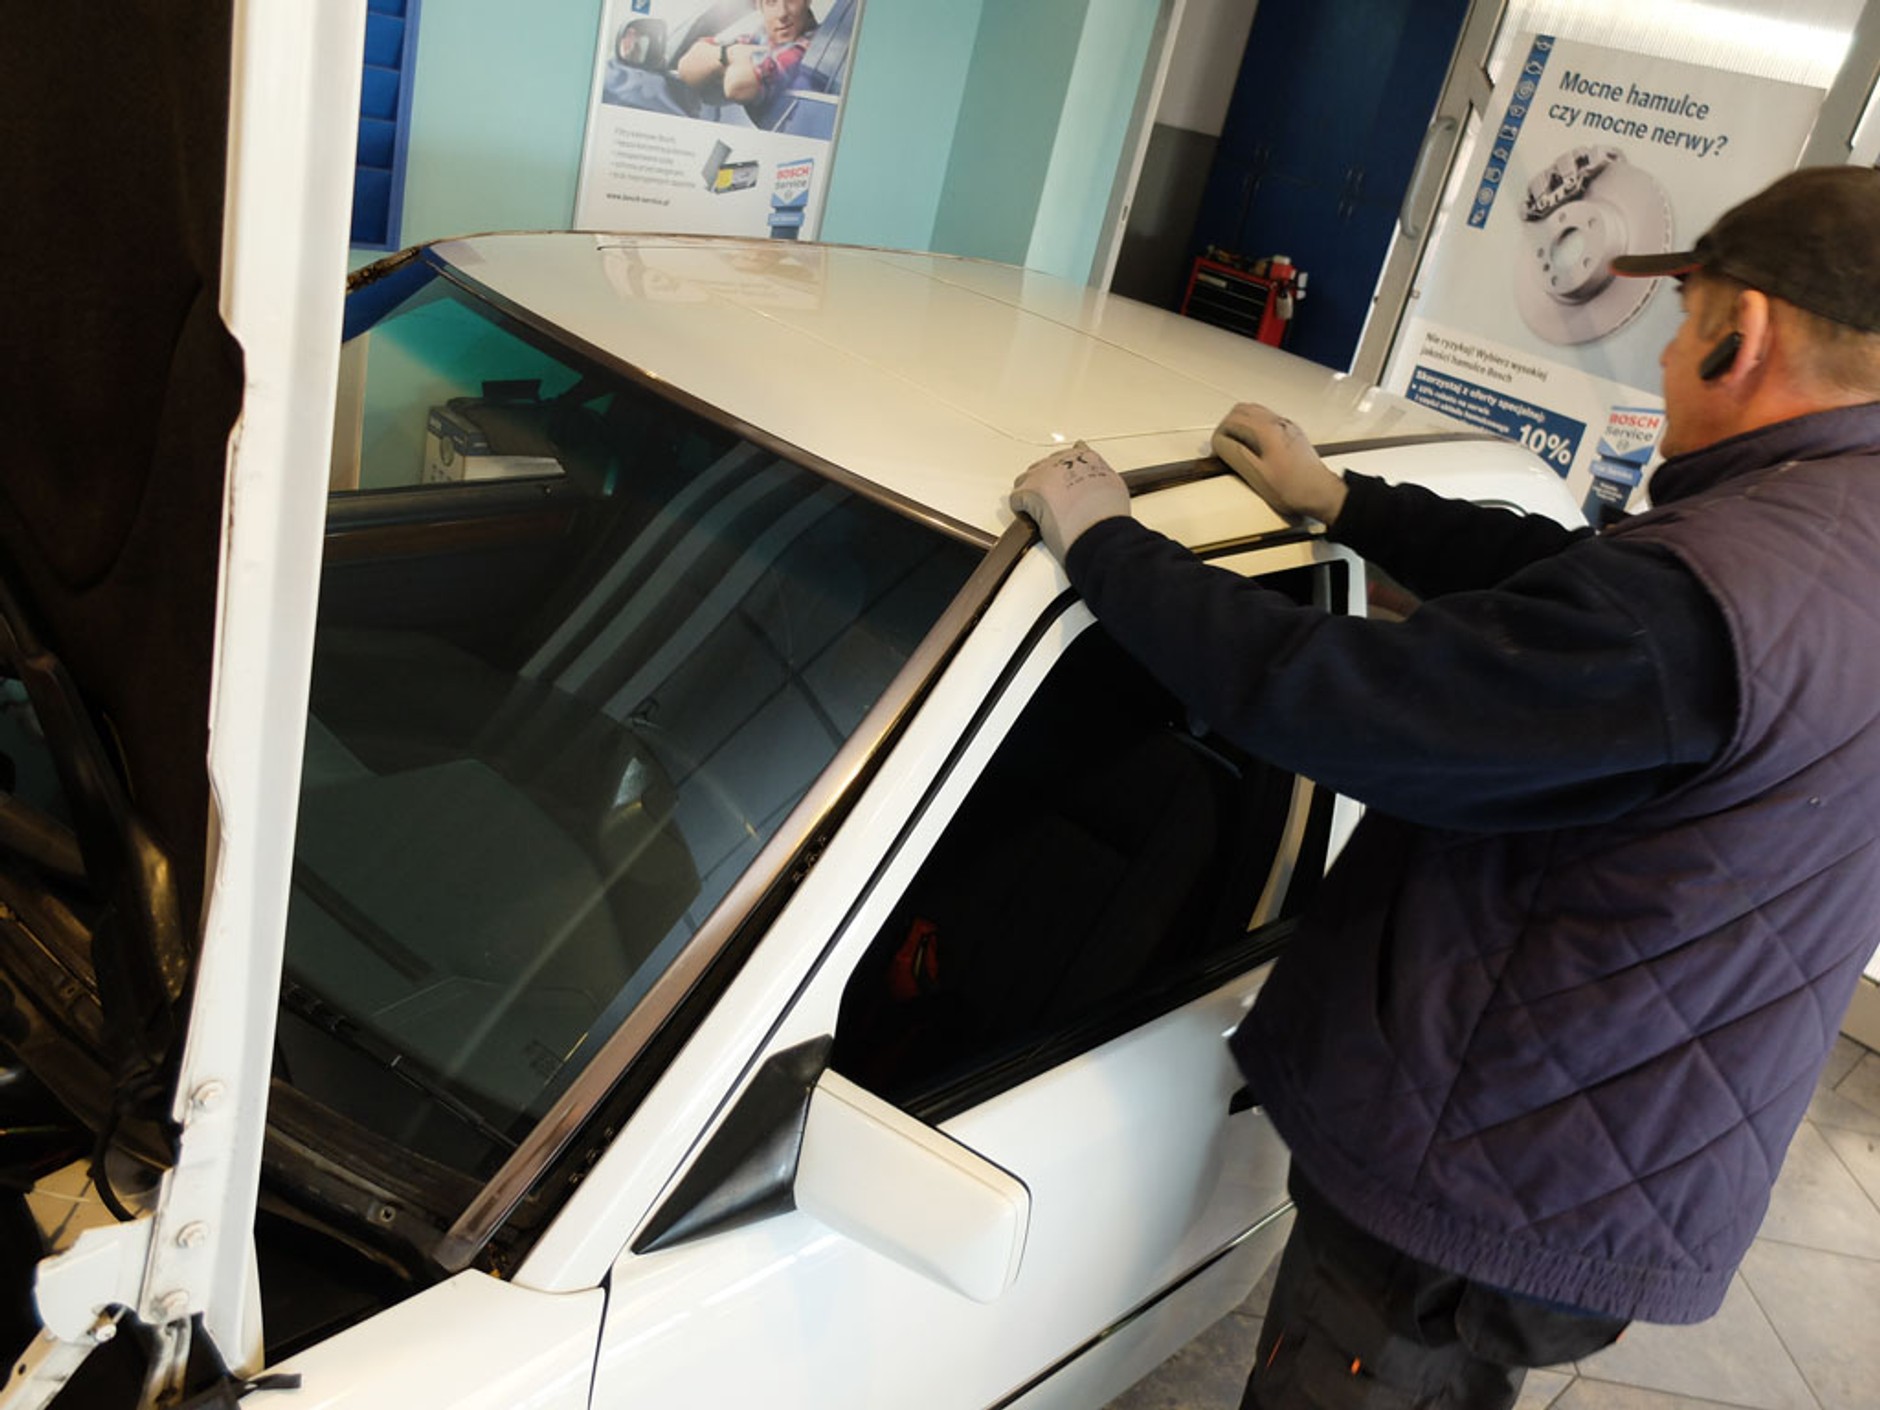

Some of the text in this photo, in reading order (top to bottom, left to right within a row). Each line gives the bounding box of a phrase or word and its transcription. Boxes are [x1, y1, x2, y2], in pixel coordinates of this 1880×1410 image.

[1559, 71, 1710, 120] Mocne hamulce
[1549, 103, 1729, 158] czy mocne nerwy?
[776, 166, 809, 180] BOSCH
[1426, 332, 1440, 344] Nie
[1487, 367, 1512, 383] Bosch
[1609, 413, 1660, 429] BOSCH
[1605, 425, 1654, 442] Service
[1519, 423, 1572, 465] 10%
